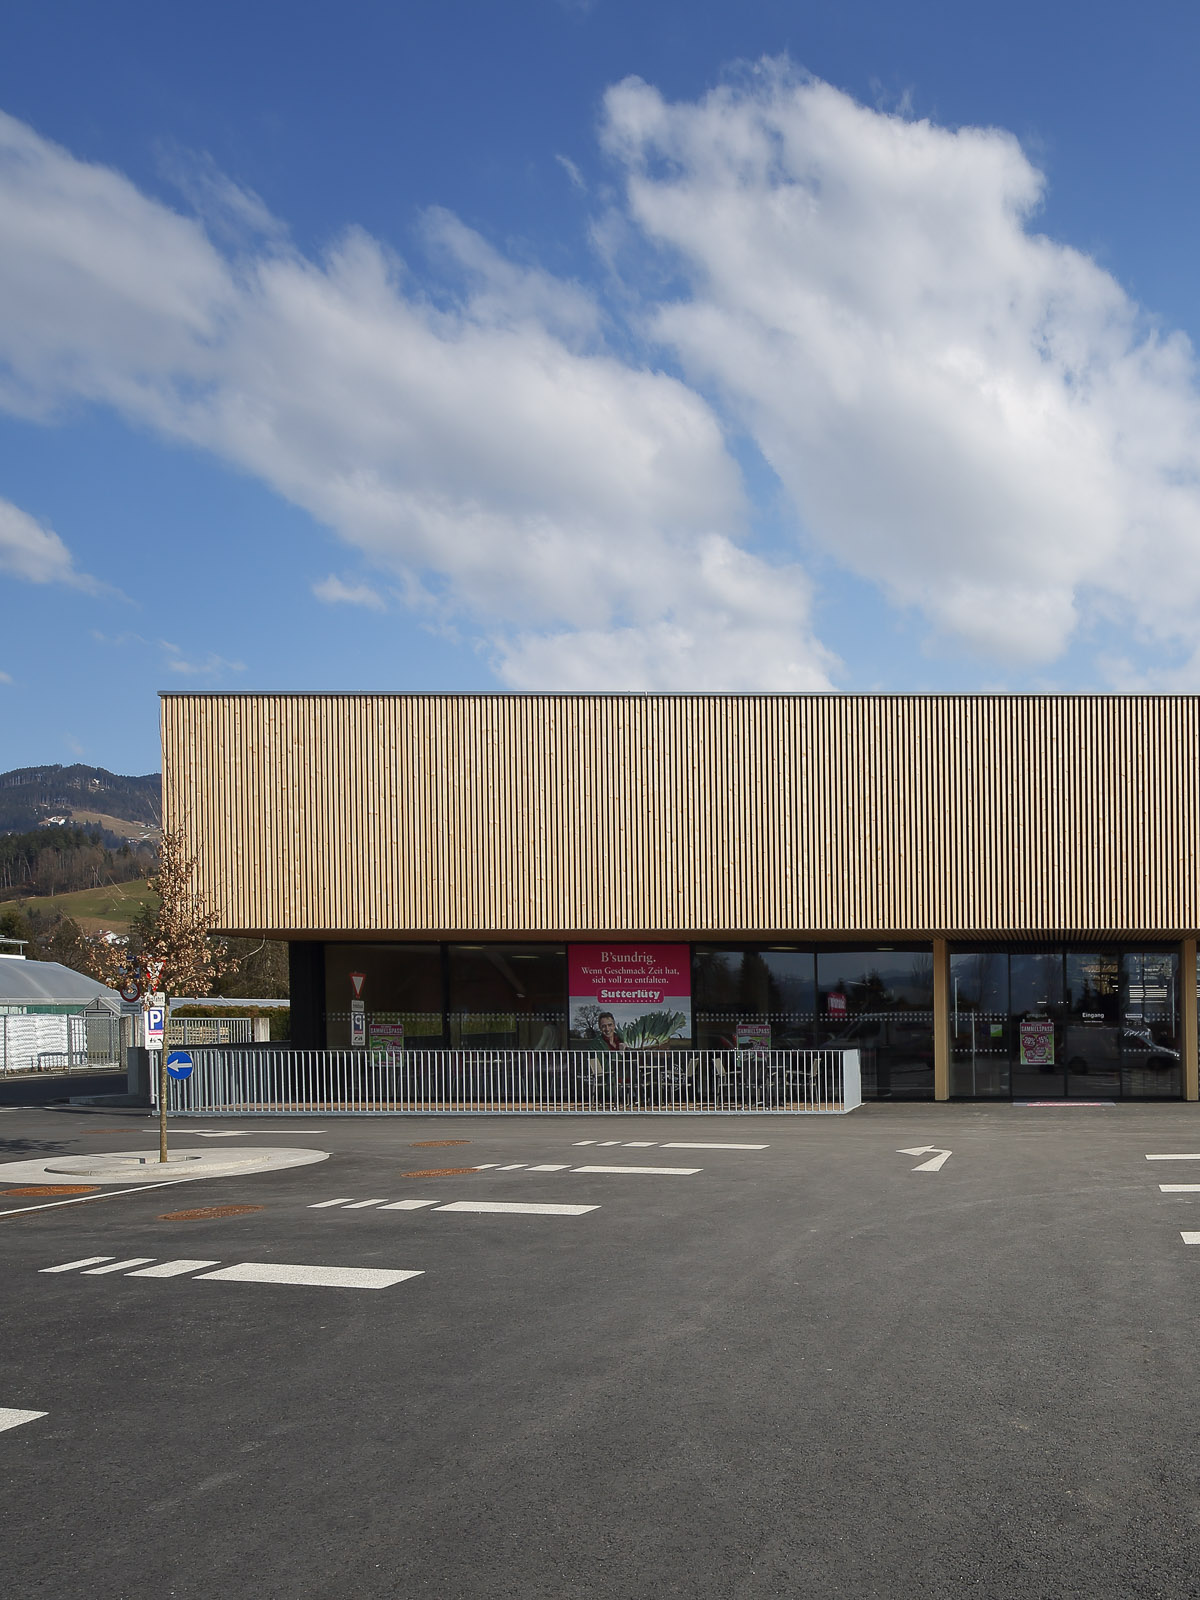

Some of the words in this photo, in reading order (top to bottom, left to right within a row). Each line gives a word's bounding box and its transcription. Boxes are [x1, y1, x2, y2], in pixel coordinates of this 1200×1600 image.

[601, 951, 656, 964] B'sundrig.
[581, 967, 602, 975] Wenn
[604, 967, 646, 975] Geschmack
[648, 967, 663, 975] Zeit
[665, 967, 679, 975] hat,
[592, 976, 606, 984] sich
[608, 976, 621, 984] voll
[634, 976, 669, 984] entfalten.
[601, 989, 660, 999] Sutterlüty
[150, 1011, 161, 1029] P
